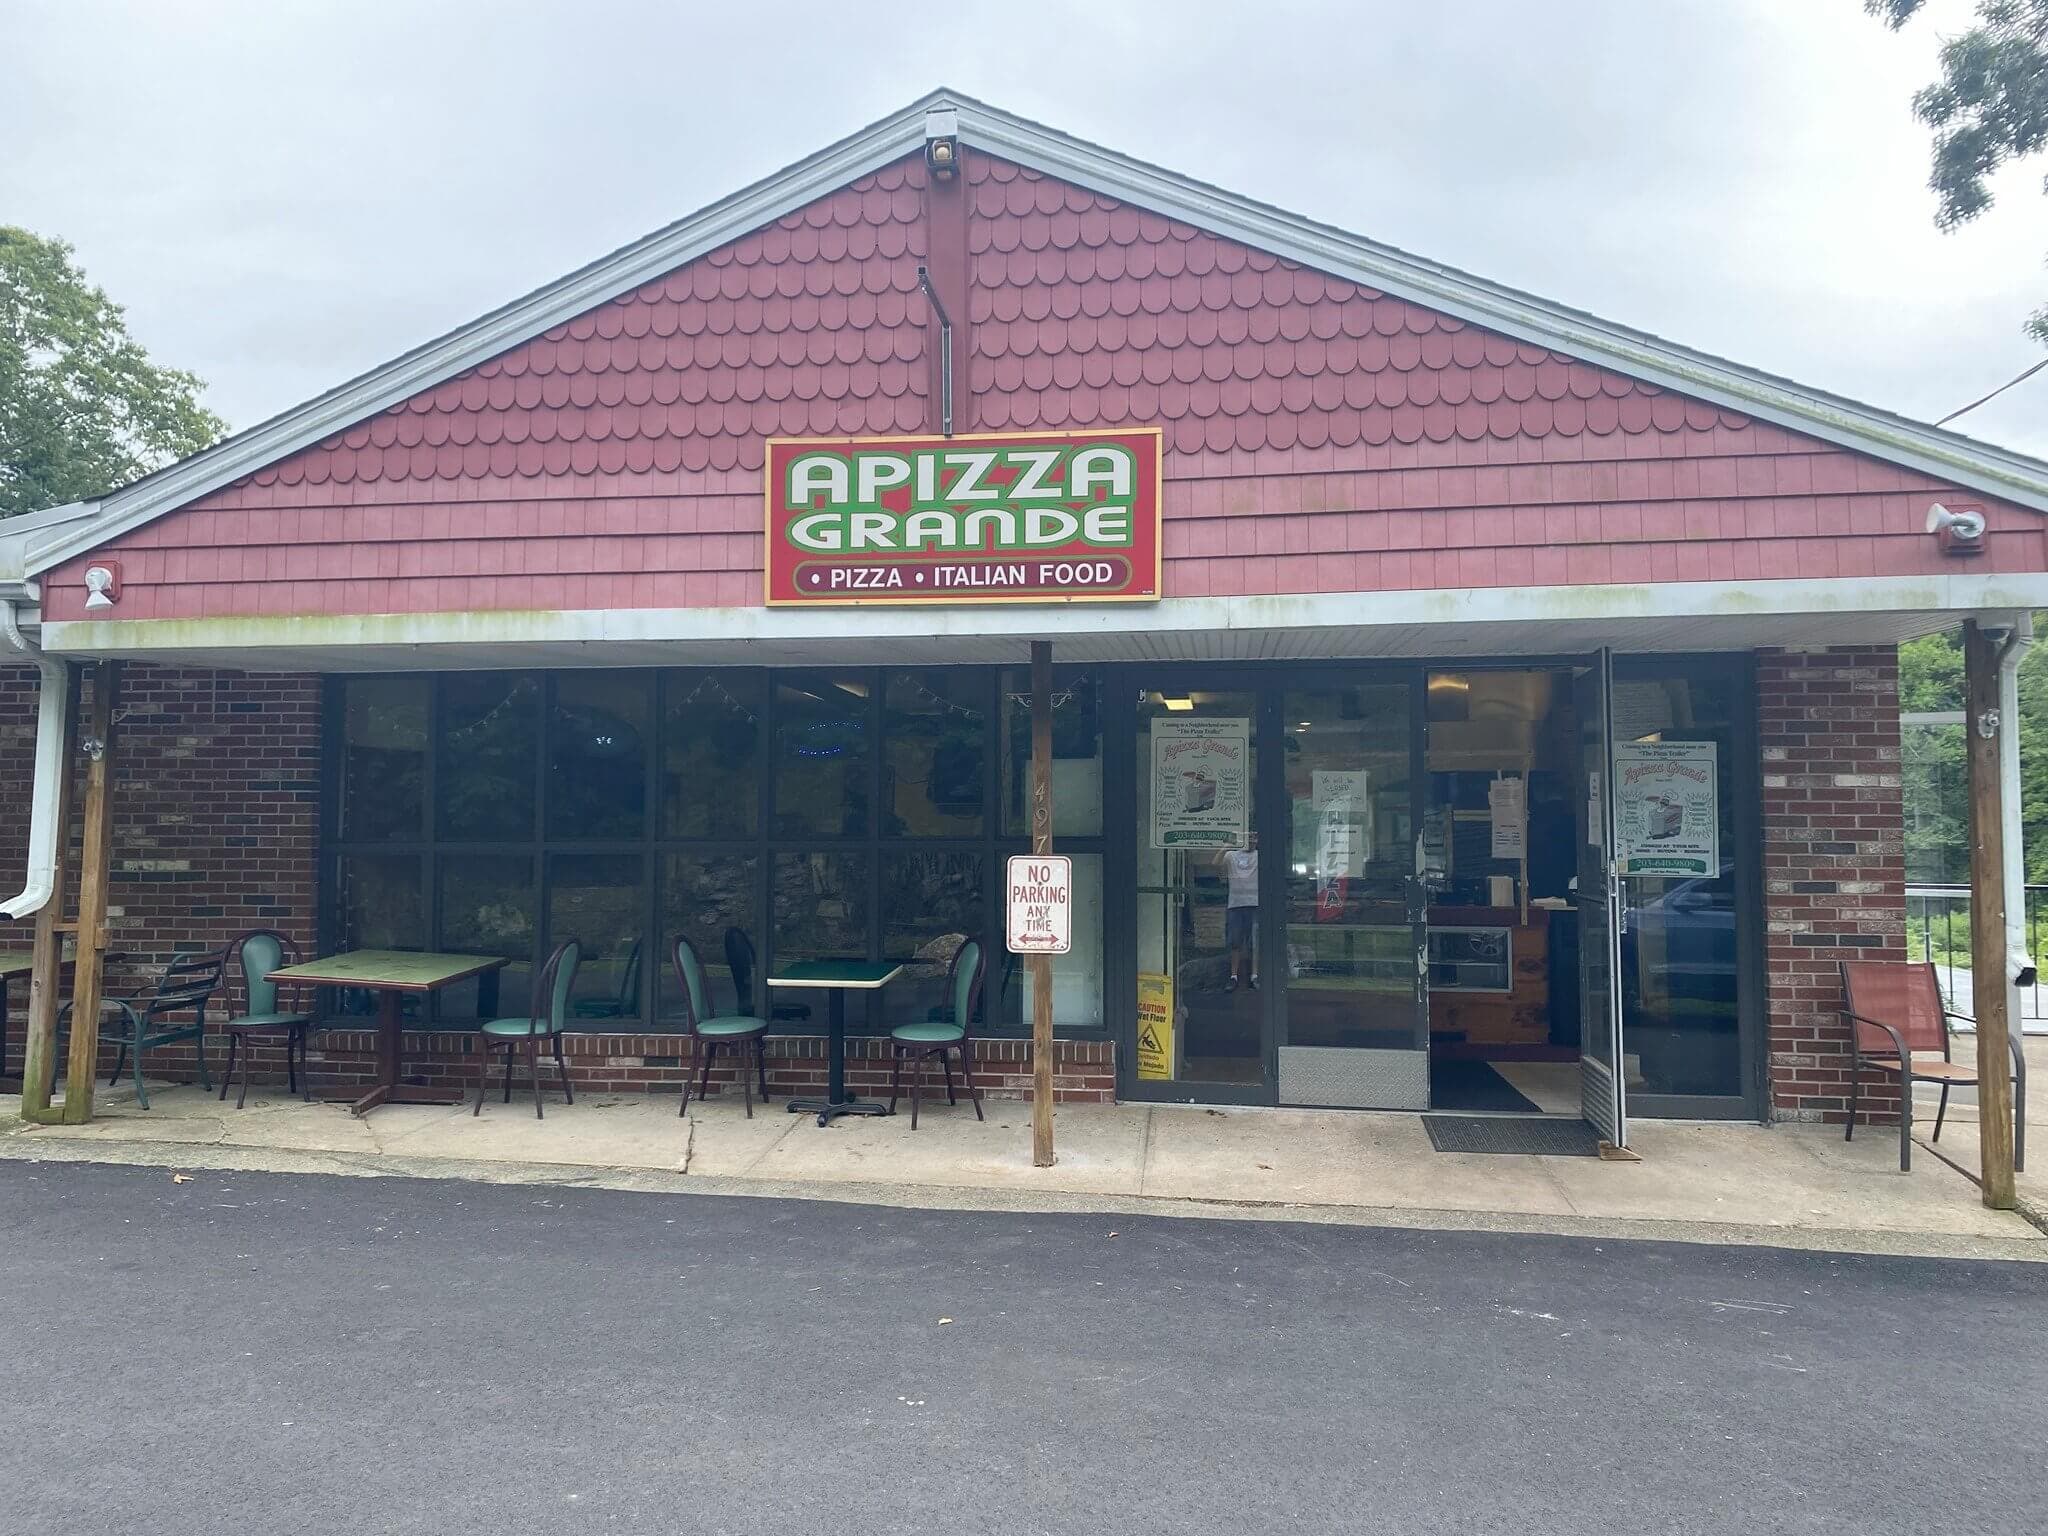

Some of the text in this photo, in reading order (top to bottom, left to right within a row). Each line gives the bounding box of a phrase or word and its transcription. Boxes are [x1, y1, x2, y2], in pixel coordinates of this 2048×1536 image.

[791, 448, 1131, 504] APIZZA
[791, 505, 1128, 549] GRANDE
[830, 563, 1113, 588] PIZZA ITALIAN FOOD
[1034, 781, 1049, 855] 497
[1028, 865, 1051, 882] NO
[1013, 886, 1066, 904] PARKING
[1026, 906, 1051, 918] ANY
[1026, 920, 1053, 932] TIME
[1137, 1003, 1166, 1014] CAUTION
[1150, 1014, 1166, 1023] Floor
